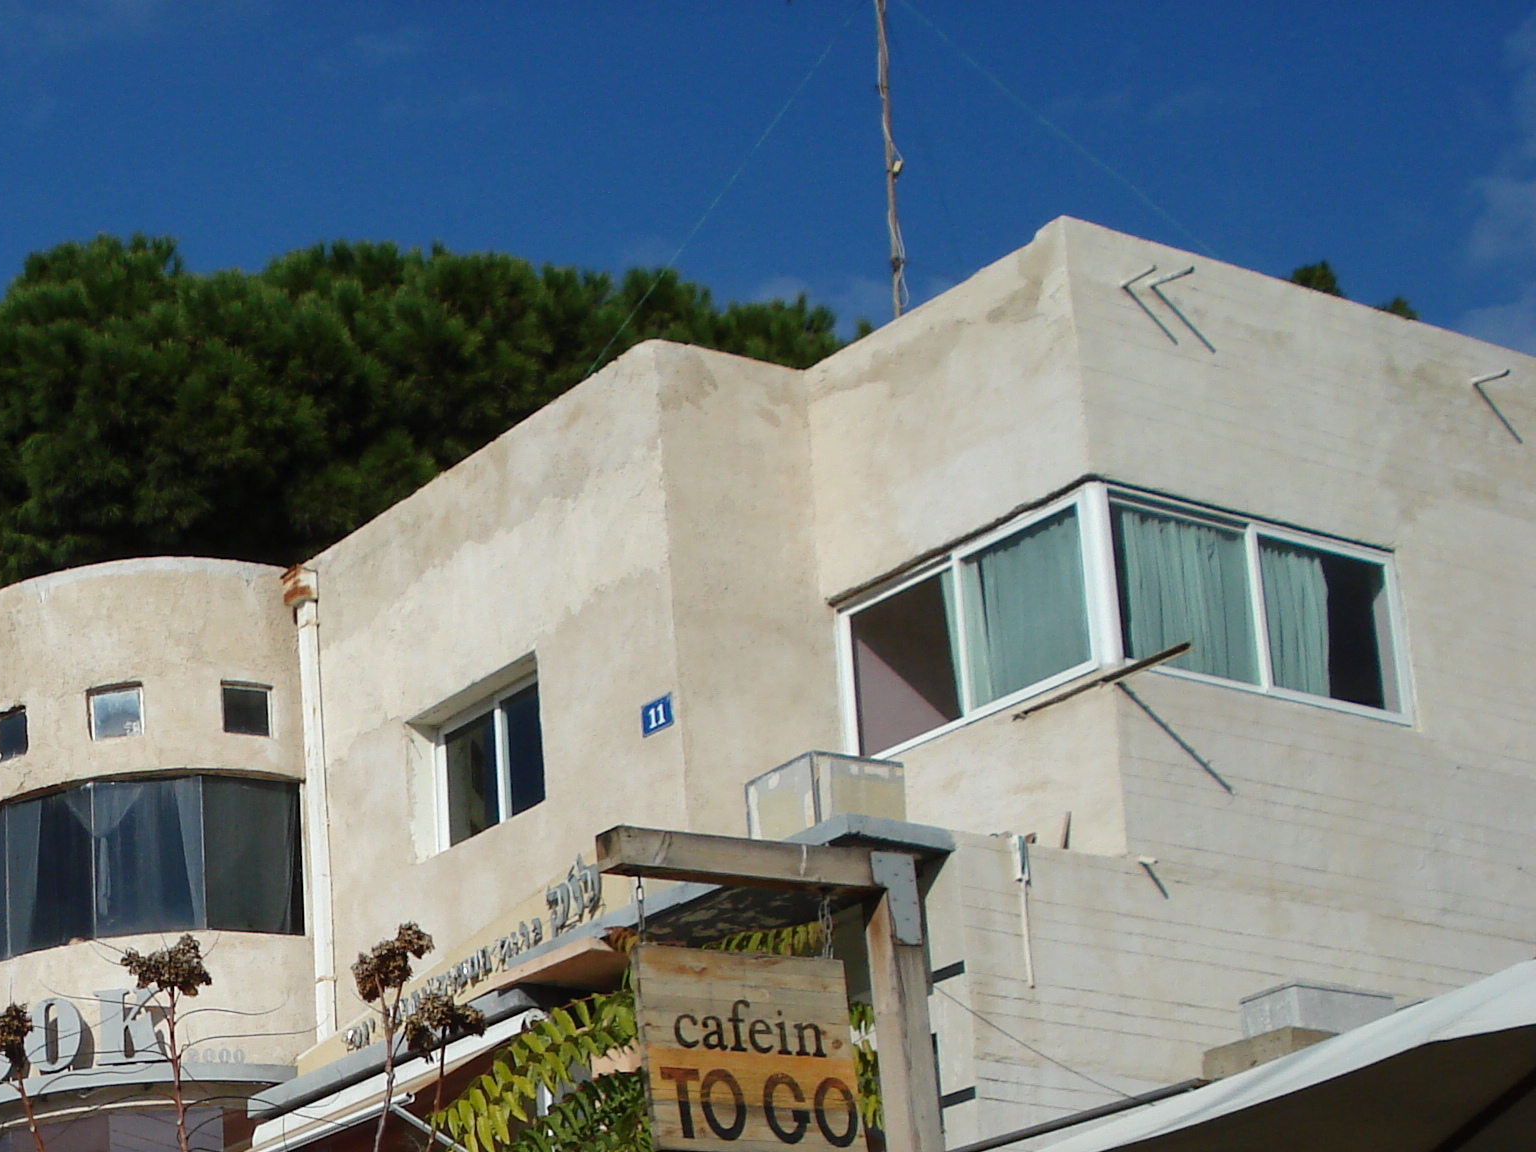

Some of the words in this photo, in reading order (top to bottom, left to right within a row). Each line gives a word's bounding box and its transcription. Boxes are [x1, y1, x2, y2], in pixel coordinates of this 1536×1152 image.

[648, 703, 666, 729] 11
[674, 1000, 827, 1058] cafein
[187, 1047, 246, 1064] 2000
[660, 1066, 747, 1141] TO
[763, 1072, 858, 1148] GO
